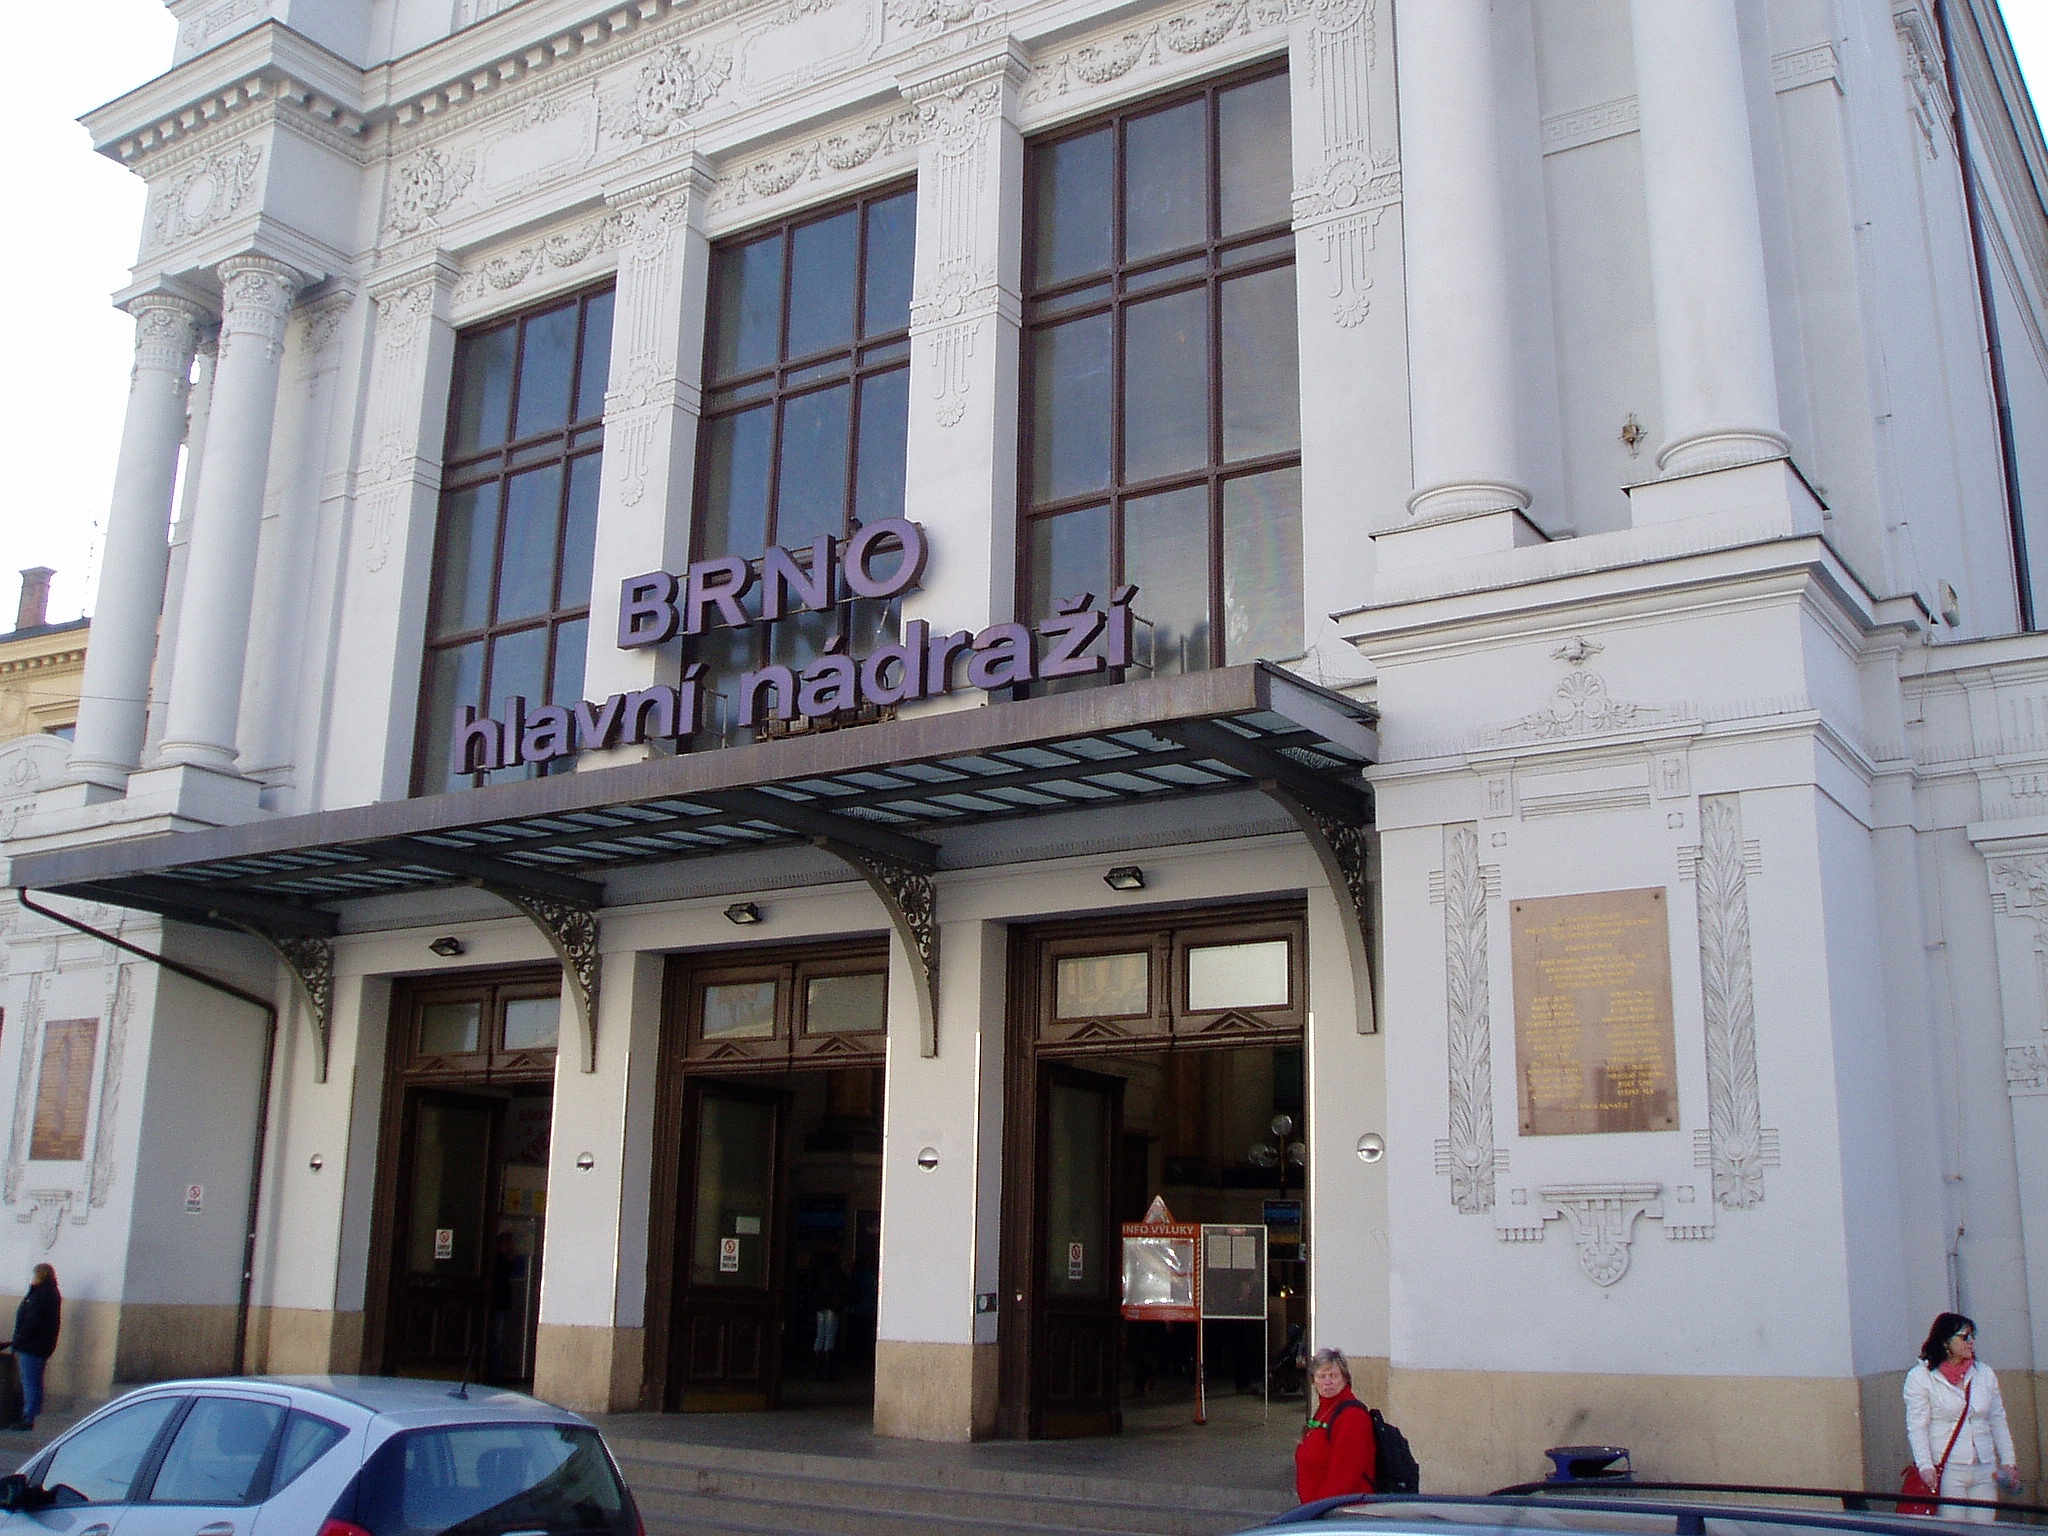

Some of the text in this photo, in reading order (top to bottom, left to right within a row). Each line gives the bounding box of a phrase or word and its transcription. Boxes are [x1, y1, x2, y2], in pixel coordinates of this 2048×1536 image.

[617, 517, 928, 650] BRNO
[454, 585, 1139, 774] hlavní nádraží
[1122, 1224, 1149, 1235] INFO
